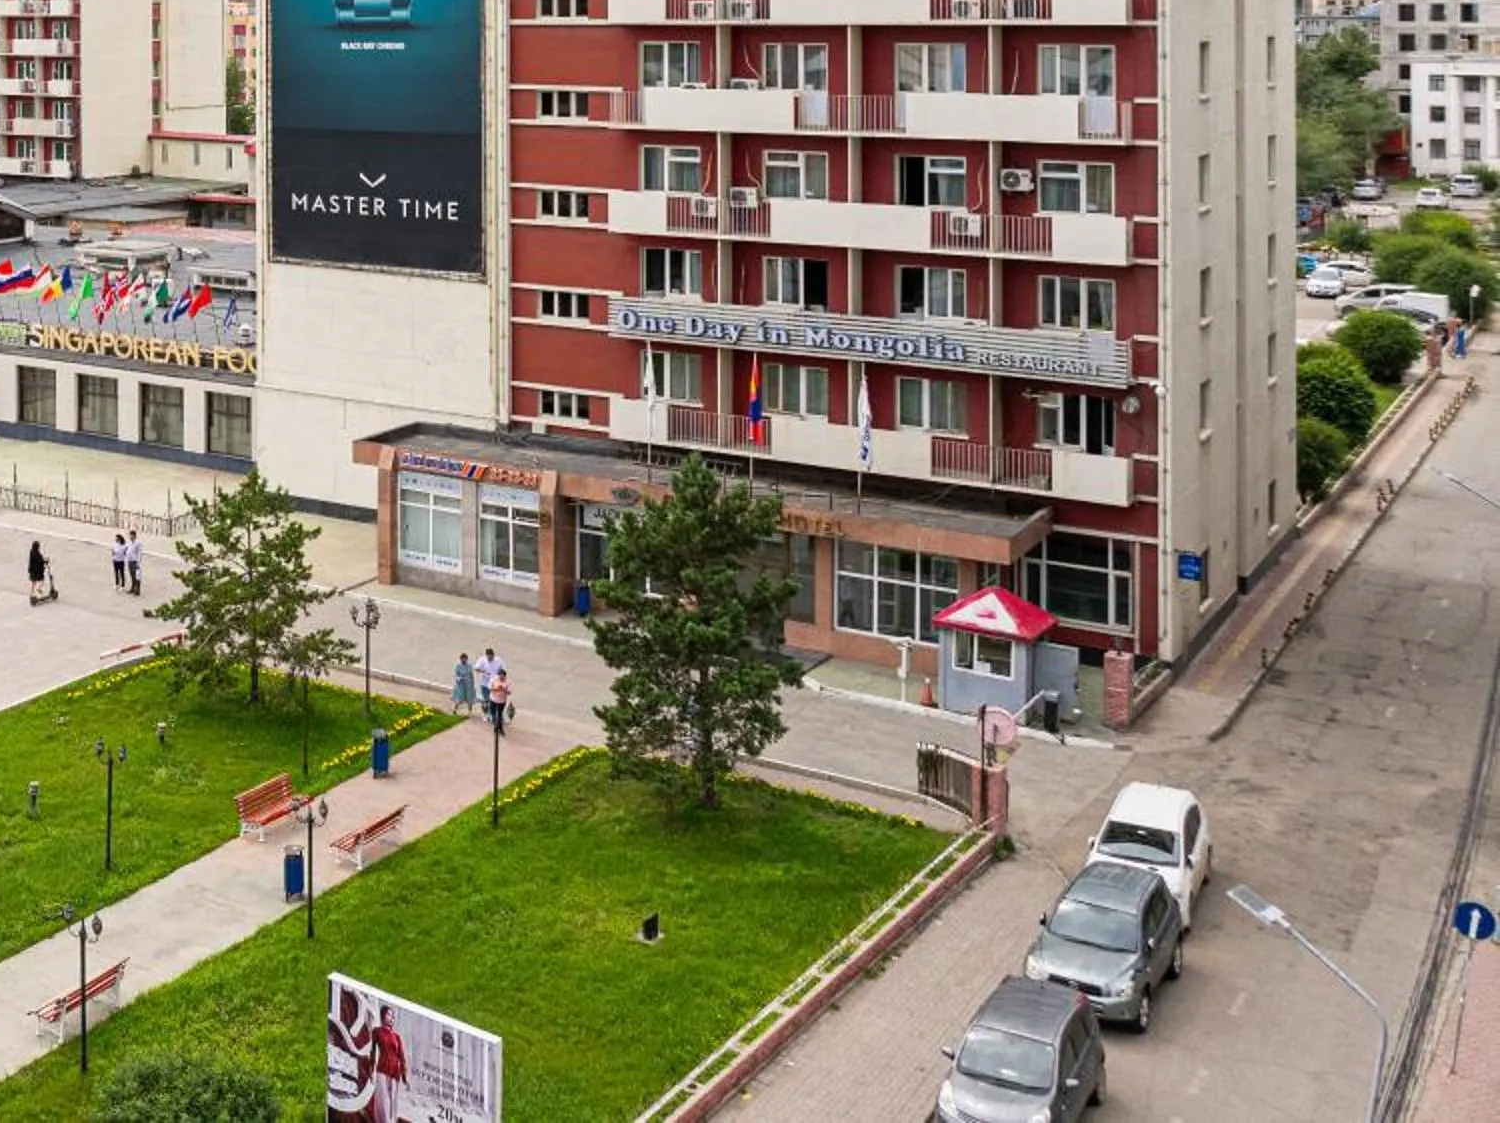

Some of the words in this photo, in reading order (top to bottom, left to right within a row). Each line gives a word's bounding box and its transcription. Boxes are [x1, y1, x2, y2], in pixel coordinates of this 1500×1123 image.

[291, 193, 387, 217] MASTER
[398, 198, 460, 221] TIME
[30, 325, 200, 368] SINGAPOREAN
[617, 309, 675, 334] One
[685, 316, 743, 344] Day
[757, 319, 790, 344] in
[804, 326, 966, 361] Mongolia
[977, 349, 1100, 376] RESTAURANT
